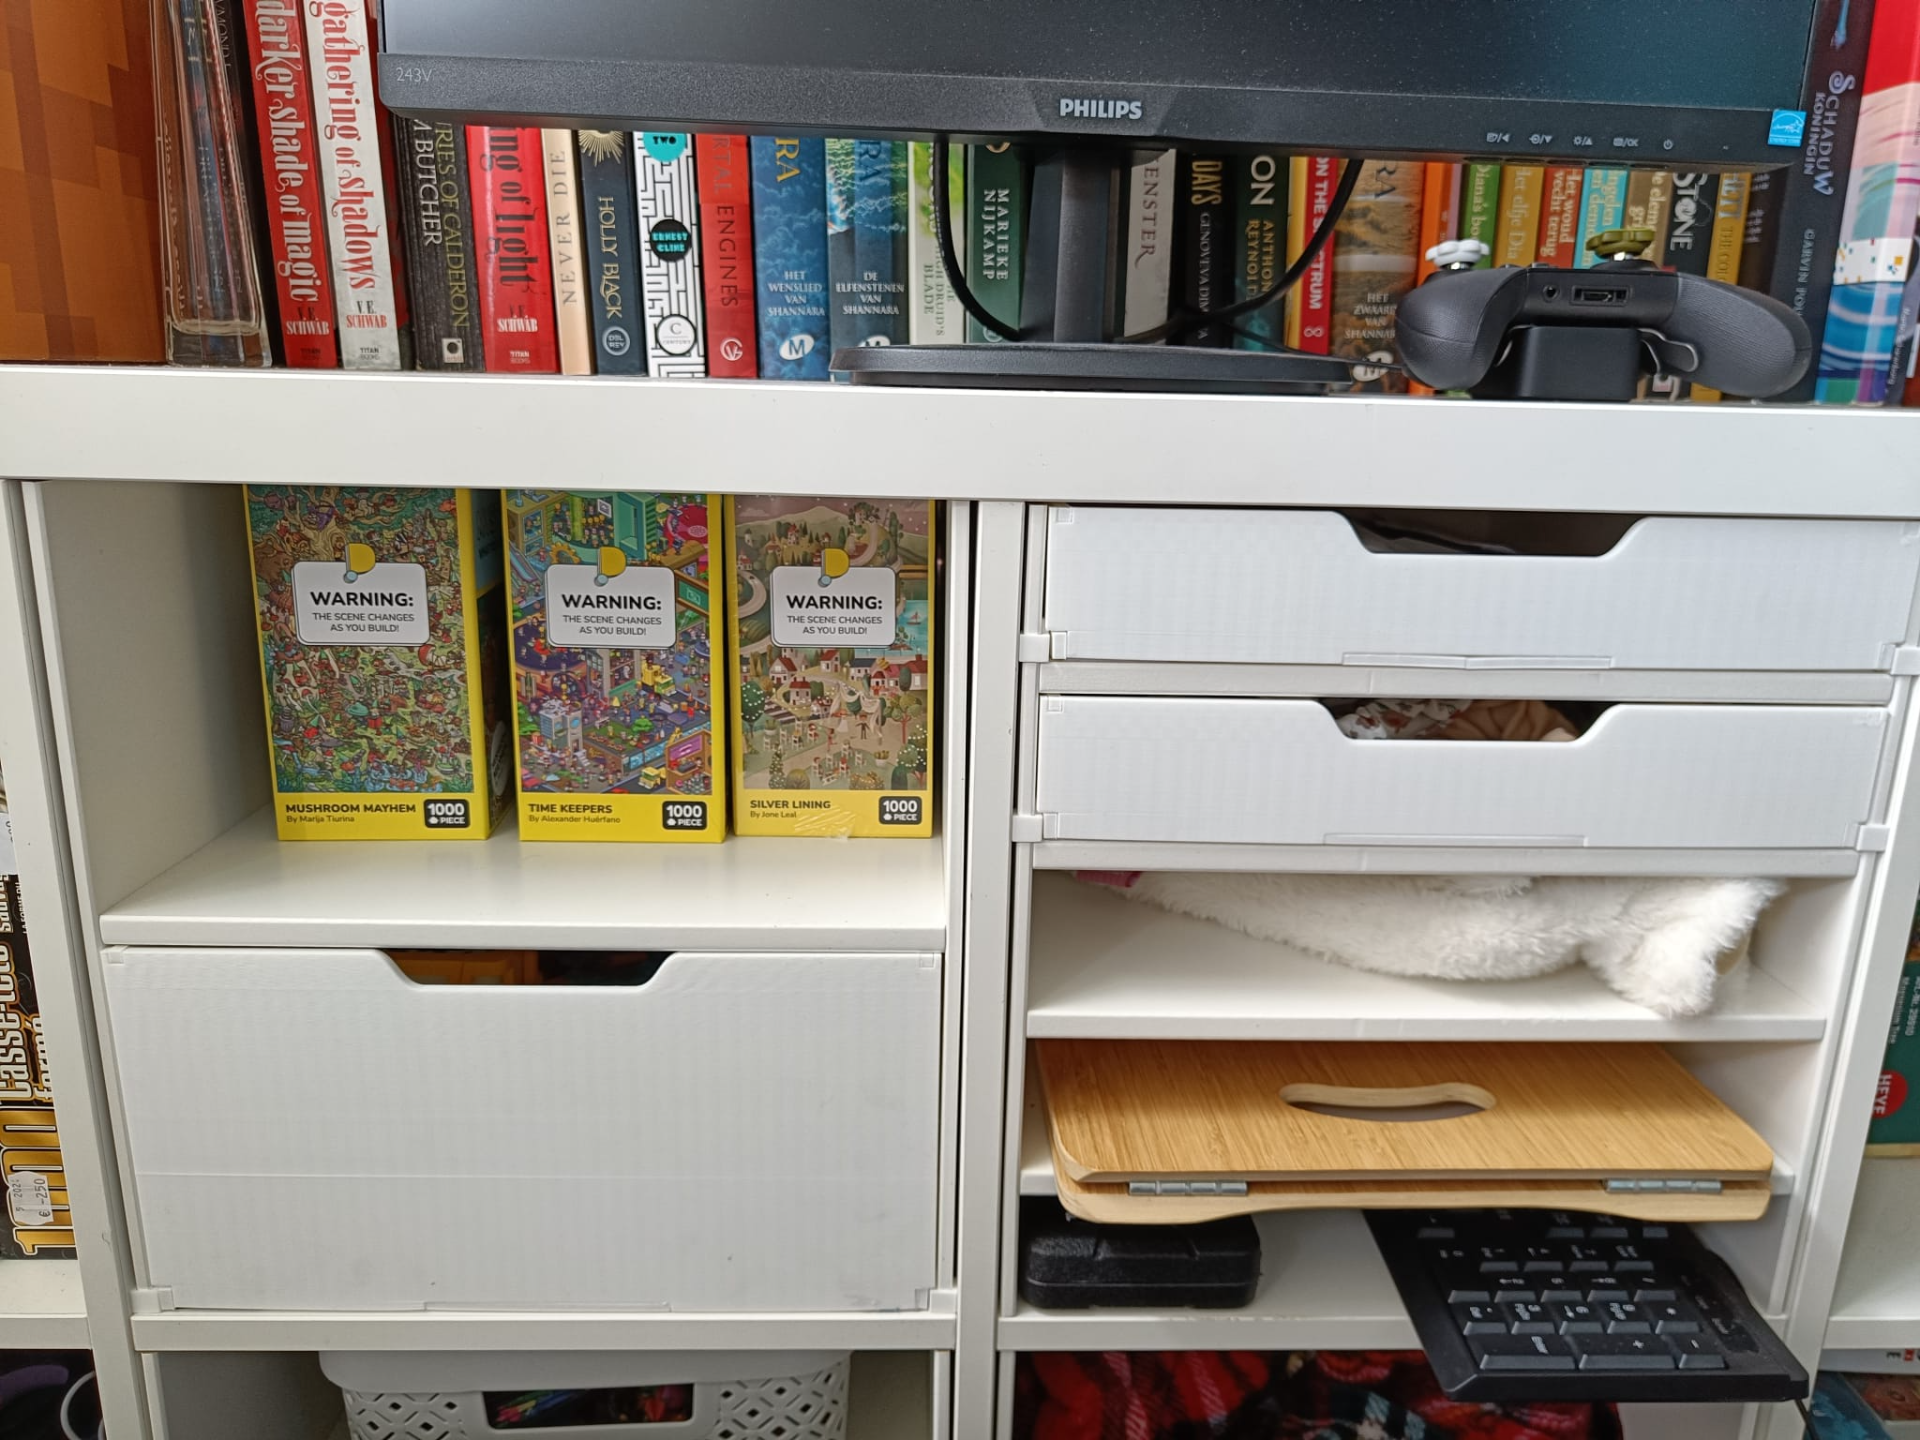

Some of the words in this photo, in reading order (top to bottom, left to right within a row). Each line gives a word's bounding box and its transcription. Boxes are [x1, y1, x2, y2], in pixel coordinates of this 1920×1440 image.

[309, 0, 365, 141] gathering
[1059, 98, 1143, 120] PHILIPS
[653, 136, 677, 144] TWO
[1803, 92, 1826, 175] KONINGIN
[1813, 70, 1856, 195] SCHADUW
[268, 98, 308, 193] shade
[335, 147, 361, 168] of
[775, 138, 800, 182] RA
[550, 151, 568, 197] DIE
[1250, 156, 1275, 205] ON
[1191, 160, 1223, 205] DAYS
[415, 139, 442, 246] BUTCHER
[440, 181, 459, 210] OF
[500, 181, 531, 205] of
[1314, 181, 1329, 214] THE
[279, 194, 307, 216] of
[331, 169, 381, 290] shadows
[598, 197, 618, 257] HOLLY
[981, 189, 996, 279] NIJKAMP
[996, 189, 1010, 280] MARIEKE
[652, 232, 688, 241] ERNEST
[1540, 216, 1559, 257] terug
[657, 244, 685, 253] CLINE
[716, 205, 738, 307] ENGINES
[277, 212, 322, 302] magic
[556, 213, 577, 306] NEVER
[1245, 220, 1260, 300] REYNOLD
[443, 213, 470, 328] CALDERON
[784, 270, 806, 280] HET
[863, 272, 878, 281] DE
[600, 263, 622, 320] BLACK
[767, 283, 823, 293] WENSLIED
[835, 283, 905, 293] ELFENSTENEN
[923, 265, 934, 314] BLADE
[784, 294, 807, 304] VAN
[860, 294, 882, 304] VAN
[767, 307, 826, 316] SHANNARA
[842, 306, 900, 315] SHANNARA
[935, 284, 945, 336] DRUID'S
[286, 321, 330, 335] SCHWAB
[346, 315, 387, 328] SCHWAB
[497, 318, 538, 332] SCHWAB
[310, 591, 414, 607] WARNING:
[561, 594, 662, 610] WARNING:
[786, 595, 883, 610] WARNING:
[312, 613, 333, 621] THE
[335, 613, 366, 622] SCENE
[368, 614, 415, 622] CHANGES
[562, 615, 582, 623] THE
[584, 616, 614, 624] SCENE
[616, 616, 662, 625] CHANGES
[807, 616, 837, 624] SCENE
[838, 616, 882, 625] CHANGES
[345, 624, 366, 632] YOU
[368, 624, 399, 632] BUILD!
[579, 626, 592, 634] AS
[594, 626, 614, 634] YOU
[616, 627, 646, 635] BUILD!
[286, 804, 360, 813] MUSHROOM
[364, 804, 416, 813] MAYHEM
[427, 803, 465, 816] 1000
[528, 804, 557, 813] TIME
[560, 804, 613, 814] KEEPERS
[666, 805, 703, 817] 1000
[750, 800, 789, 809] SILVER
[792, 800, 831, 809] LINING
[883, 800, 918, 813] 1000
[286, 816, 297, 824] By
[300, 815, 325, 824] Marija
[326, 815, 355, 823] Tiurina
[528, 815, 539, 823] By
[541, 815, 581, 823] Alexander
[750, 811, 760, 819] By
